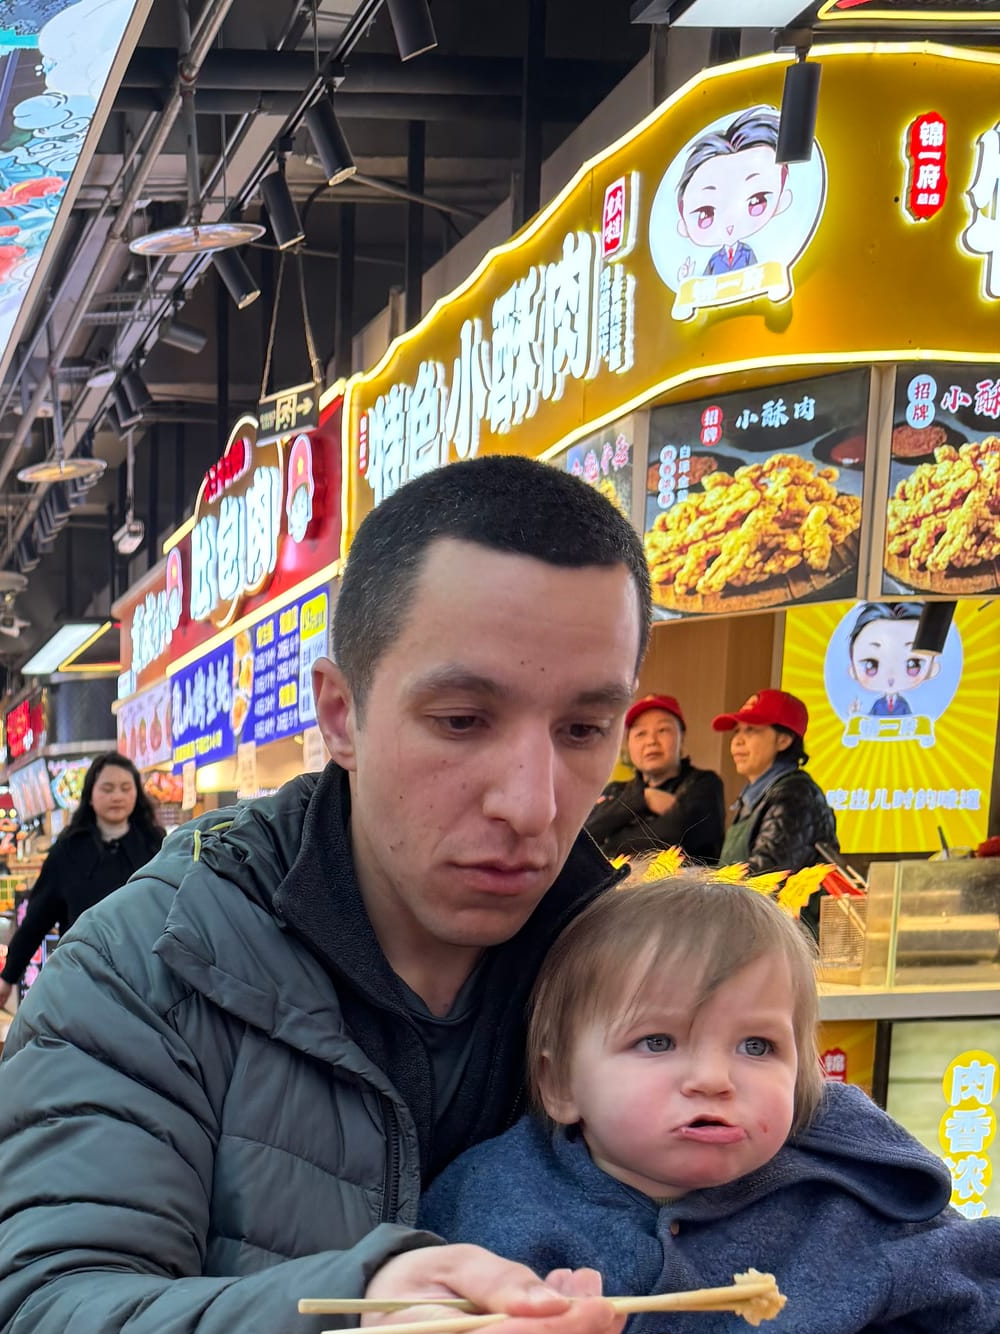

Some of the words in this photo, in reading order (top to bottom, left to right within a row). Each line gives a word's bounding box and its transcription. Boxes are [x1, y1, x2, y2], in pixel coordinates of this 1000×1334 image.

[915, 121, 944, 190] 锦一府
[735, 396, 817, 430] 小酥肉
[912, 382, 931, 421] 招牌
[826, 788, 981, 810] 吃出儿时的味道
